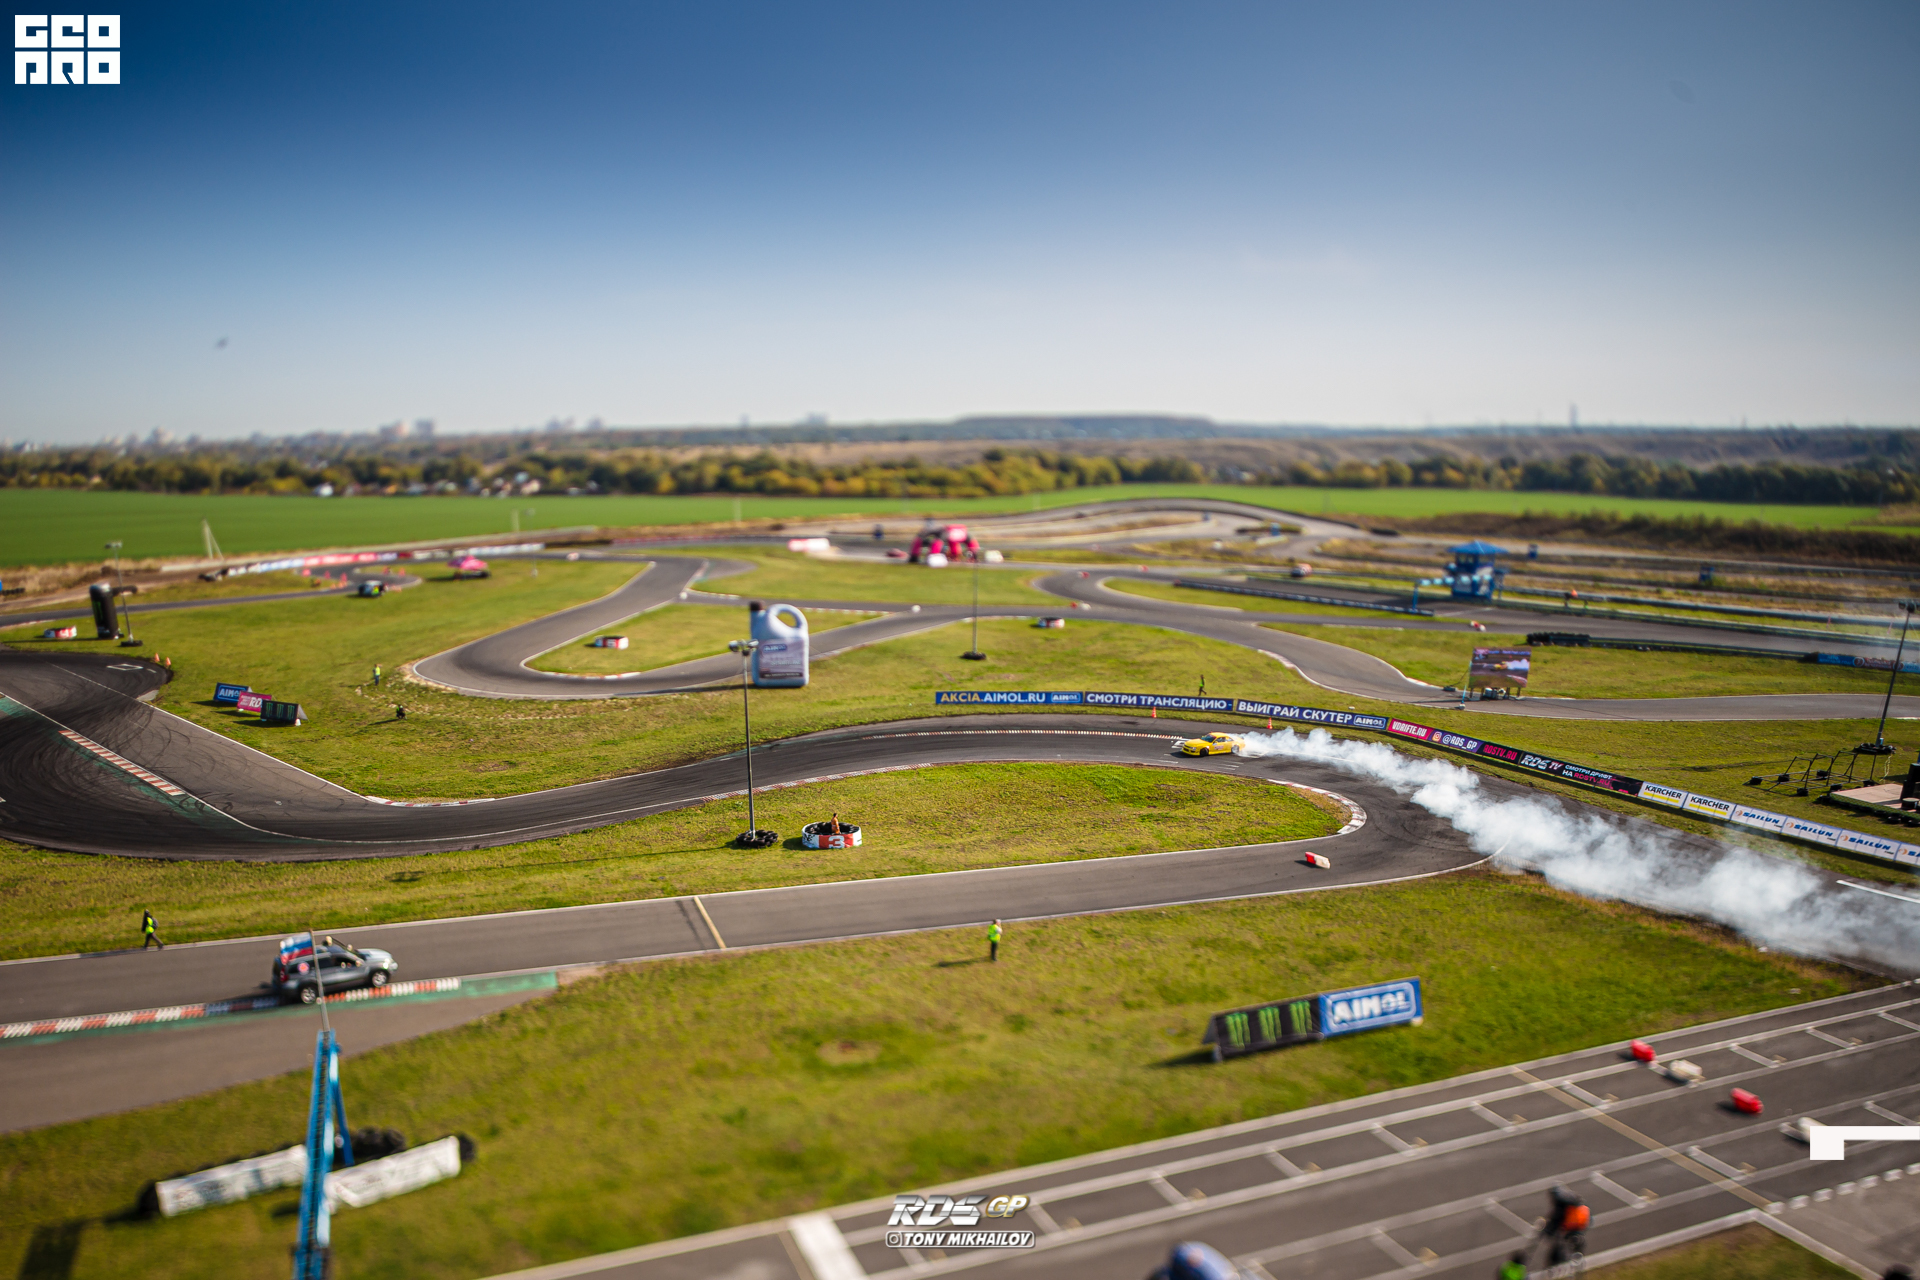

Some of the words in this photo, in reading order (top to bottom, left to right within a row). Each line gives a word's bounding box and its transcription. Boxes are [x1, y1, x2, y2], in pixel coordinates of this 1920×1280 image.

[219, 688, 240, 698] AIMO
[941, 692, 1046, 702] AKCIA.AIMOL.RU
[1087, 693, 1137, 704] СМОТРИ
[249, 696, 262, 708] RD
[1238, 701, 1300, 718] ВЫИГРАЙ
[1302, 709, 1353, 723] СКУТЕР
[1355, 716, 1383, 726] AIMOL
[1392, 721, 1427, 737] VDRIFTE.RU
[1442, 734, 1478, 750] @RDS_GP
[1483, 744, 1518, 760] RDSTV.RU
[1521, 754, 1550, 770] RDS
[1549, 761, 1565, 770] TV
[1743, 812, 1780, 824] SAILUN
[1794, 824, 1833, 837] SAILUN
[828, 835, 845, 848] 3
[1848, 837, 1891, 850] SAILUN
[1333, 991, 1410, 1024] AIMOL
